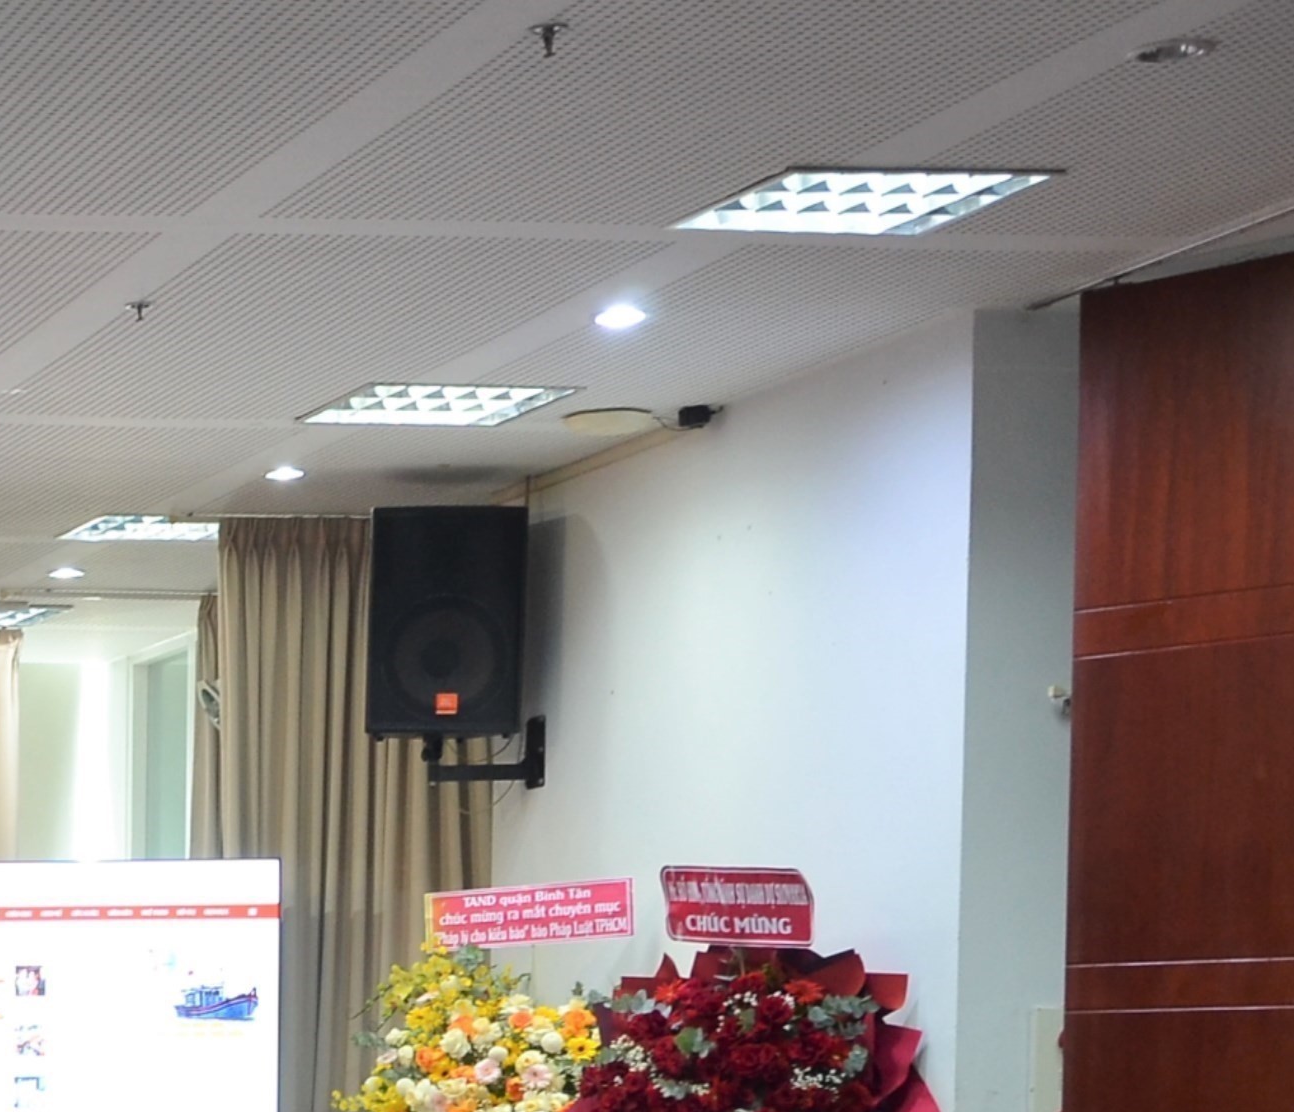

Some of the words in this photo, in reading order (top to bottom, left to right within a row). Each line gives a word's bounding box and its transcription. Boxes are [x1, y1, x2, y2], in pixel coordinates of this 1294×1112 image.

[464, 893, 497, 908] TAND
[499, 891, 532, 908] quận
[568, 887, 591, 900] Tân
[439, 910, 467, 926] chúc
[507, 910, 519, 921] ra
[548, 902, 592, 920] chuyên
[594, 901, 621, 914] mục
[685, 912, 731, 933] CHÚC
[733, 913, 792, 935] MỪNG
[471, 928, 487, 942] cho
[594, 917, 628, 933] TPHCM
